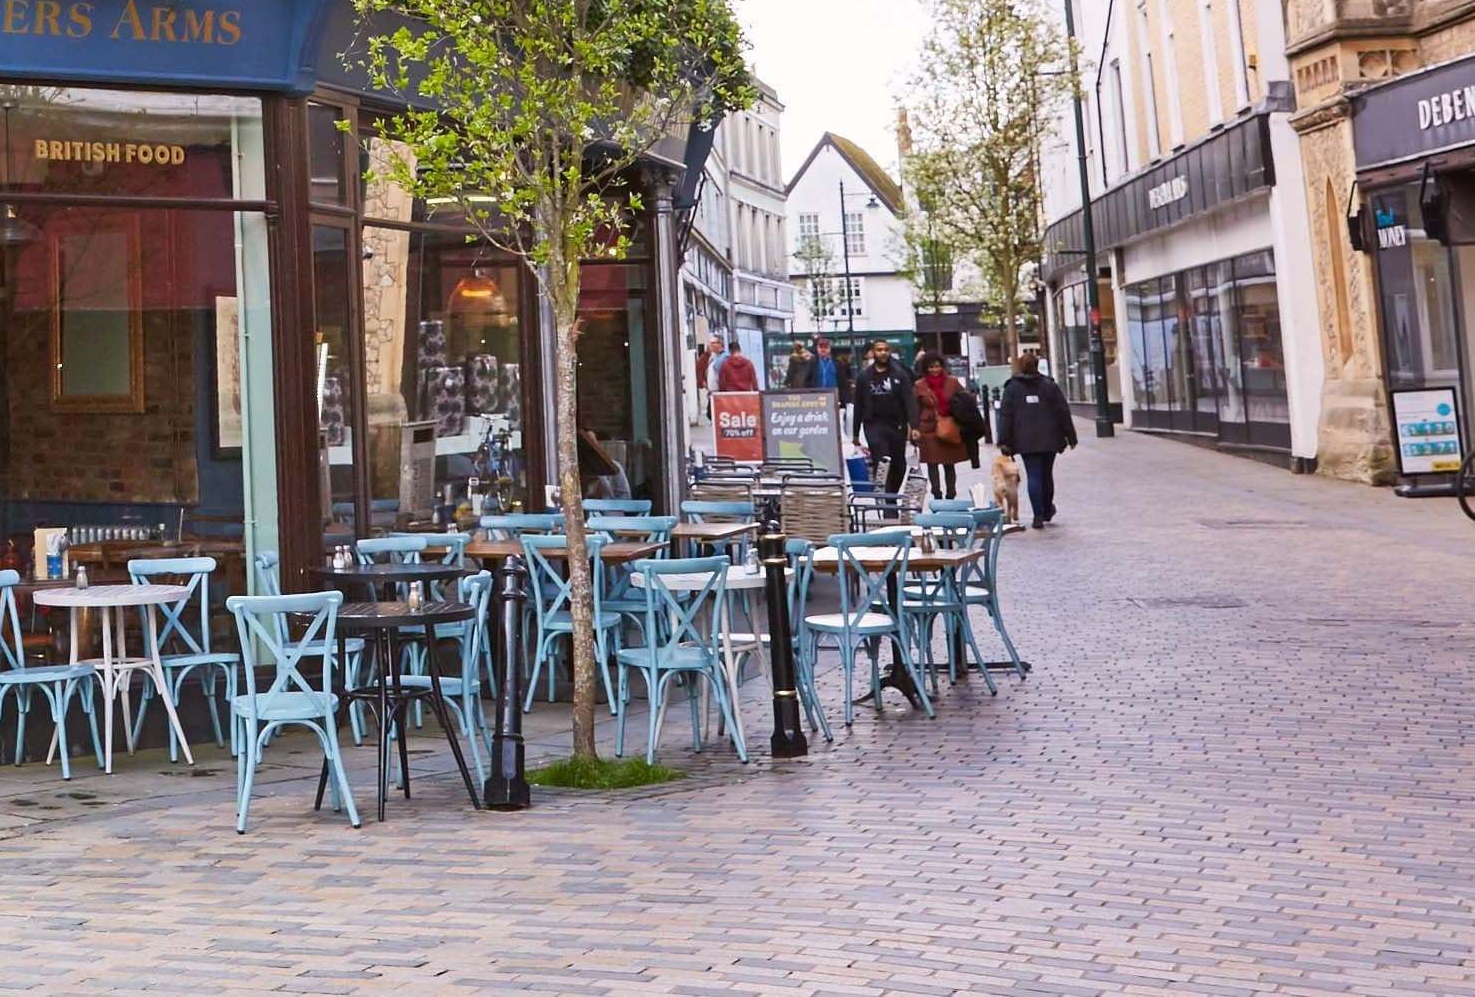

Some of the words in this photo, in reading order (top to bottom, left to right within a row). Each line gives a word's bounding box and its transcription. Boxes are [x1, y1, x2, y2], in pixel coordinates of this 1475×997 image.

[34, 139, 121, 163] BRITISH
[126, 144, 186, 165] FOOD
[719, 411, 757, 428] Sale
[771, 412, 796, 427] Enjoy
[804, 411, 829, 423] drink
[741, 428, 754, 436] off
